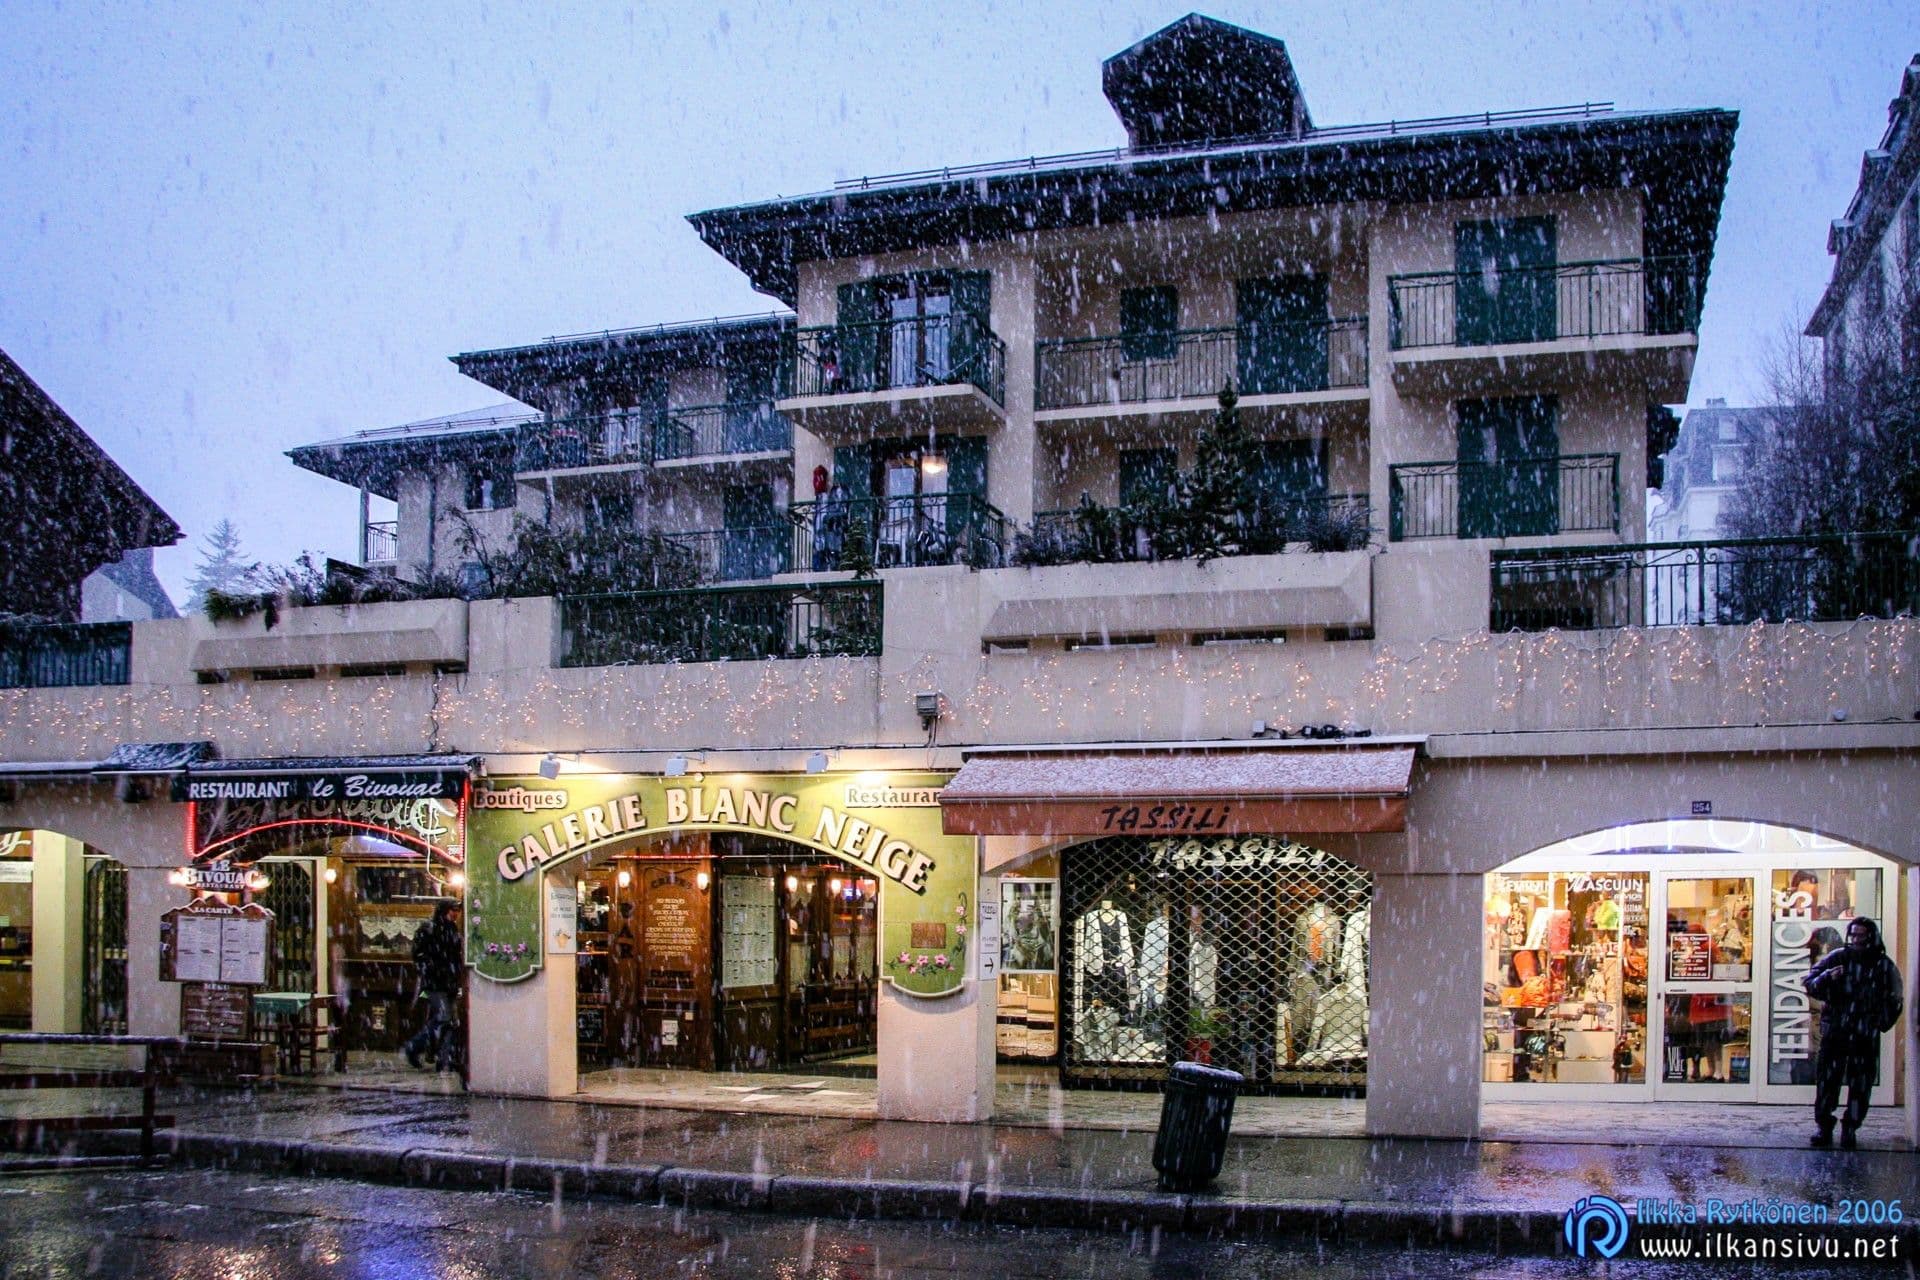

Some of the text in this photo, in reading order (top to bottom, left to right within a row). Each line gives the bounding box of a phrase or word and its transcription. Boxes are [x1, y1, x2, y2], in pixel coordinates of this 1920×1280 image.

[189, 775, 443, 799] RESTAURANT le Bivouac
[848, 788, 941, 803] Restauran
[476, 789, 563, 809] Boutiques
[497, 795, 647, 881] GALERIE
[665, 787, 798, 832] BLANC
[813, 806, 935, 893] NEIGE
[211, 859, 230, 871] LE
[184, 867, 260, 888] BIVOUAC
[1772, 889, 1813, 1064] TENDANCES
